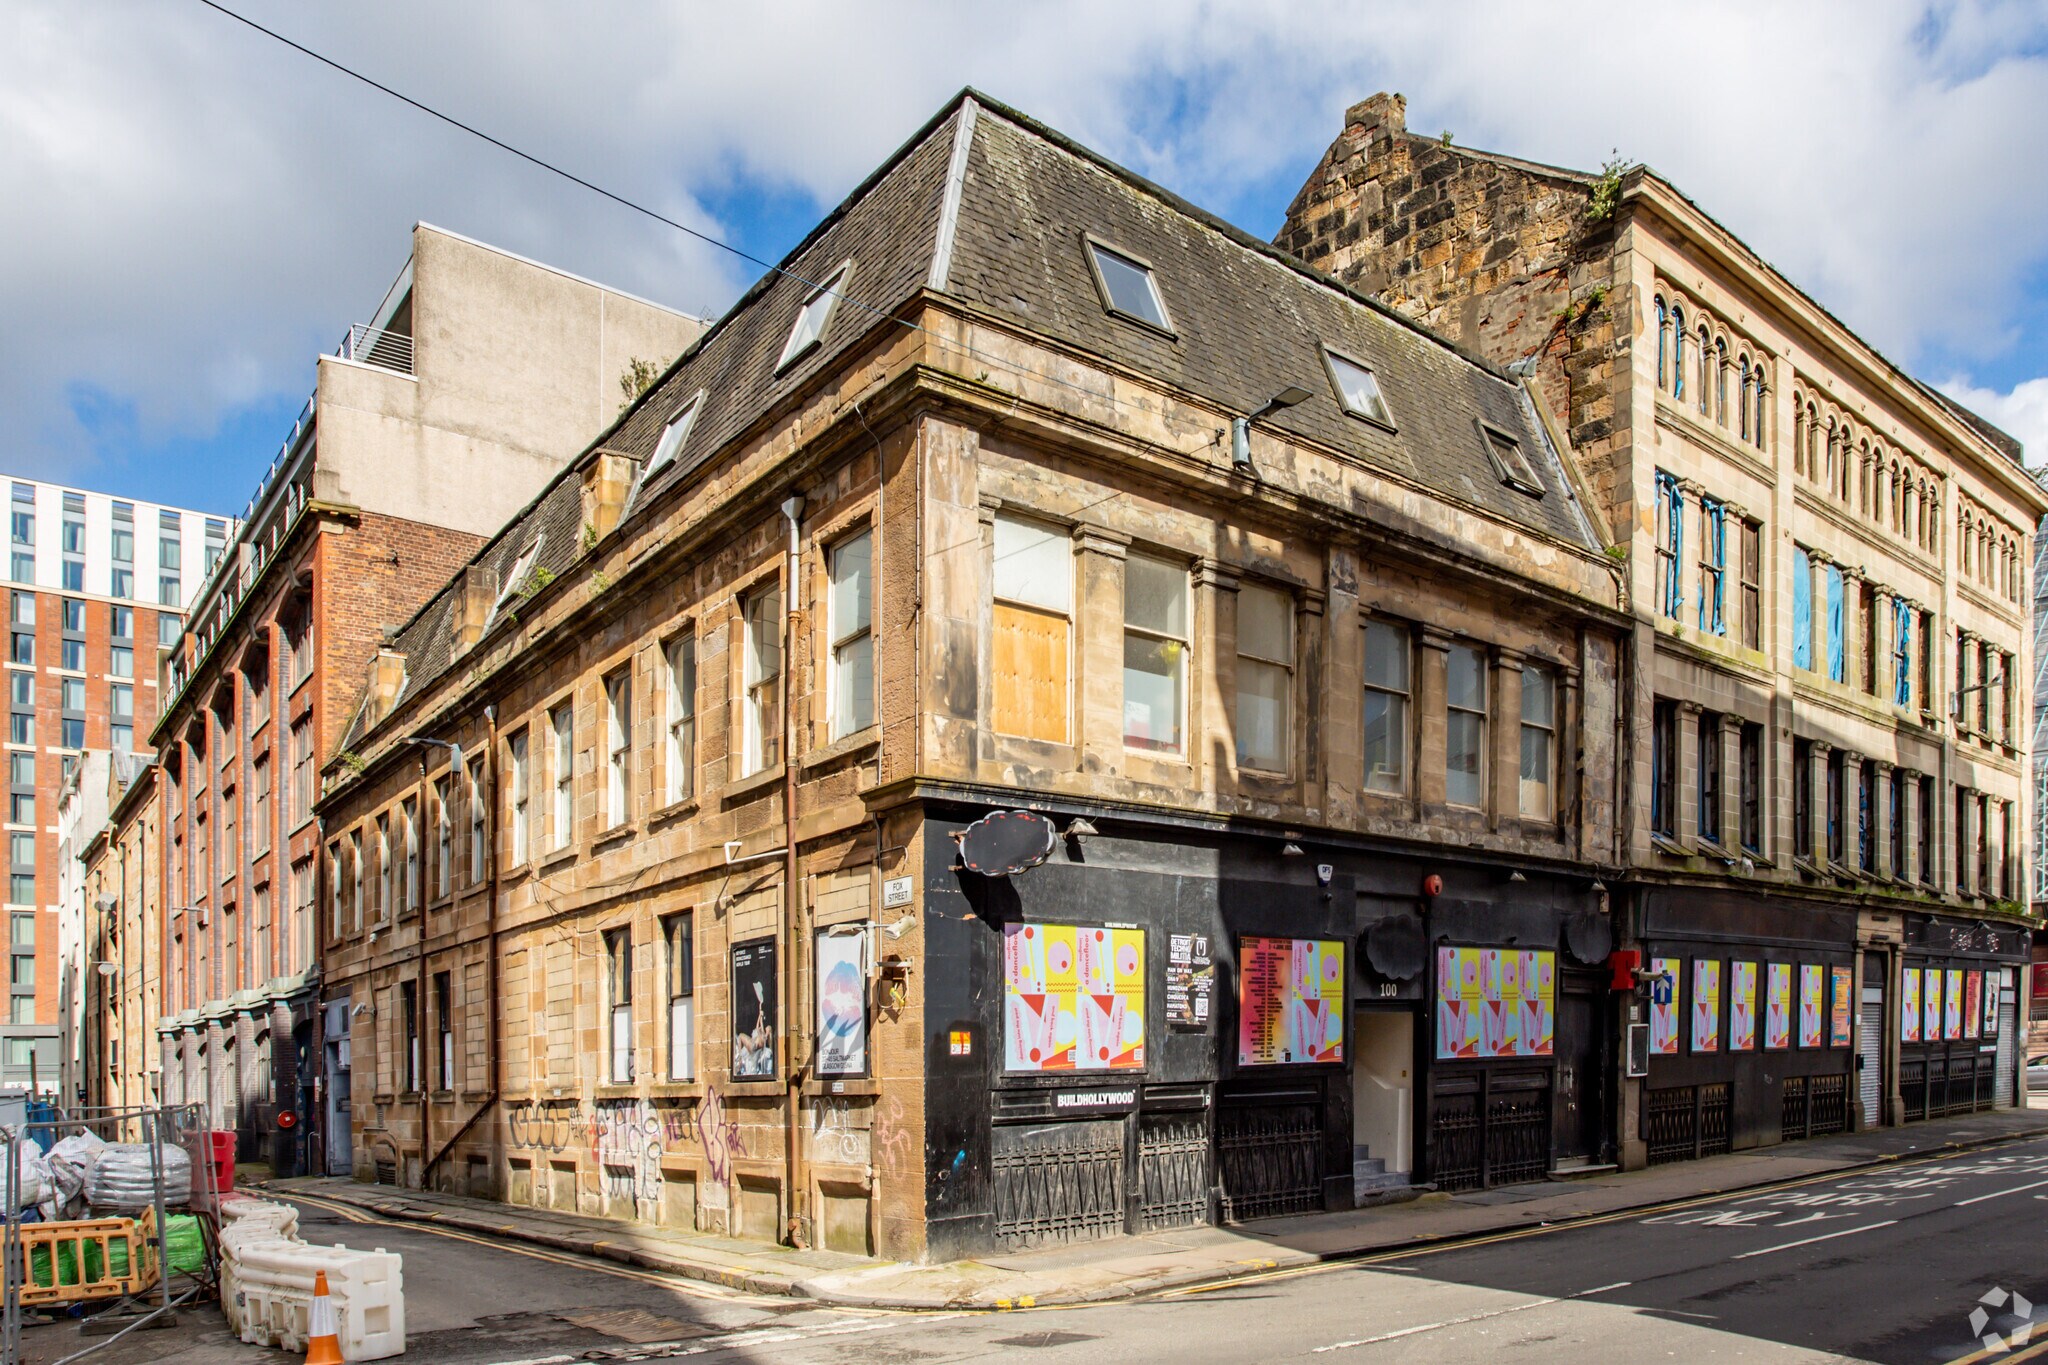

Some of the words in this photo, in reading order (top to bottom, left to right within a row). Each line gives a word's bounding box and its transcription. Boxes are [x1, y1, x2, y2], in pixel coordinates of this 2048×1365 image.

[893, 882, 903, 891] FOX
[888, 890, 908, 902] STREET
[1170, 938, 1191, 946] DETROIT
[1170, 952, 1191, 960] MILITIA
[1380, 983, 1397, 997] 100
[1057, 1091, 1134, 1107] BUILDHOLLYWOOD
[1731, 1192, 1935, 1206] PARK
[1638, 1210, 1860, 1227] ONLY
